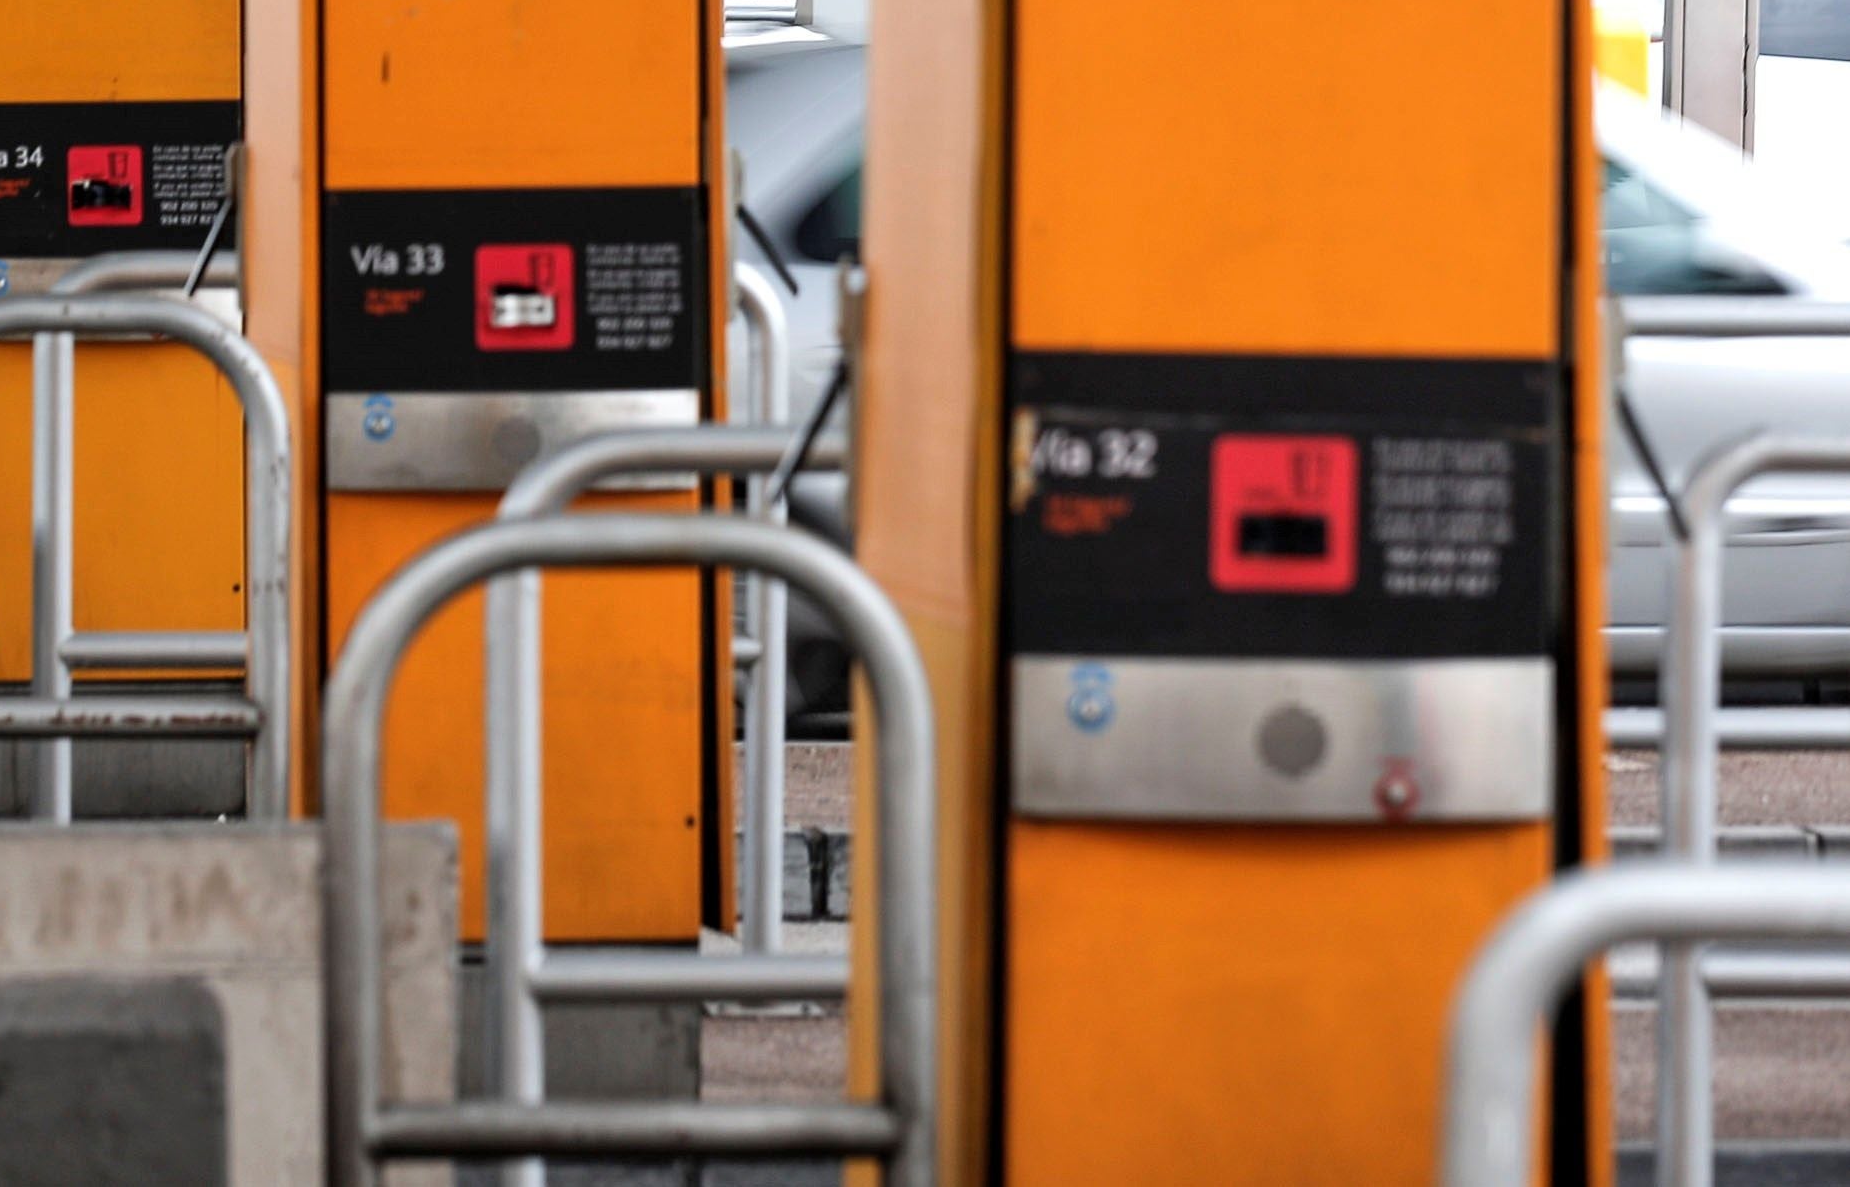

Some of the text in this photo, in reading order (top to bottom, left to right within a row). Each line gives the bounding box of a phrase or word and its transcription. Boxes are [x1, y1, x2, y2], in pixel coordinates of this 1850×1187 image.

[14, 144, 44, 168] 34
[406, 244, 445, 275] 33
[1098, 427, 1158, 478] 32
